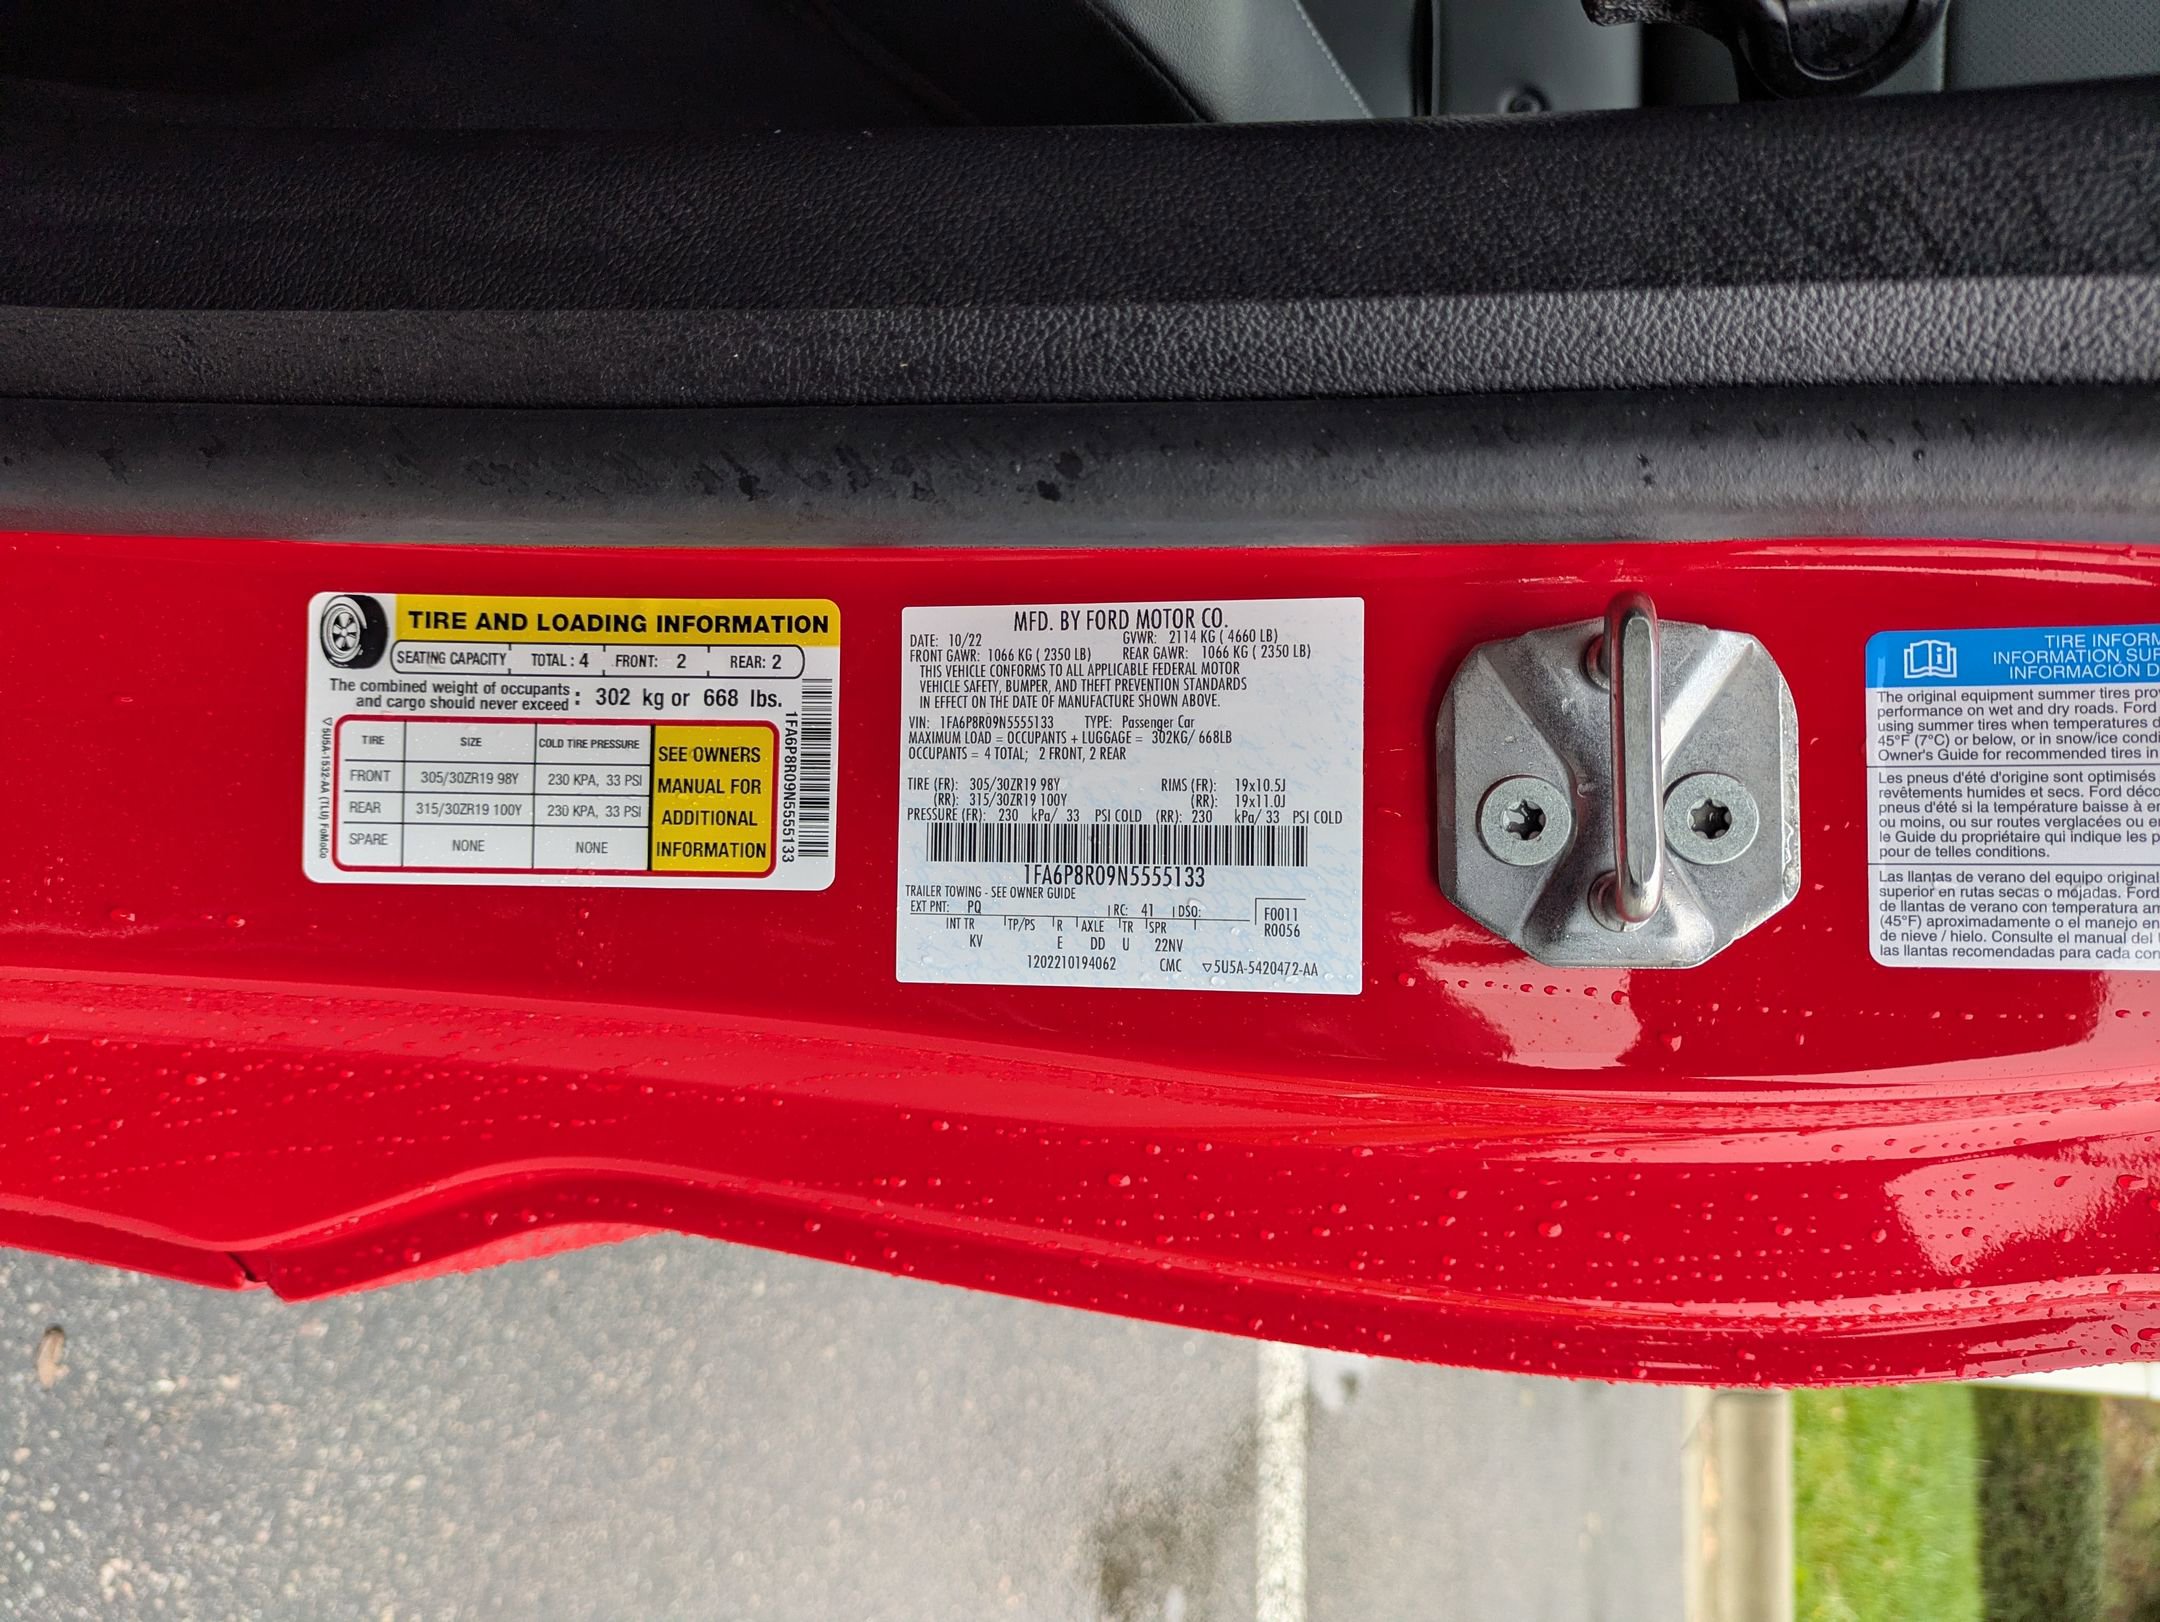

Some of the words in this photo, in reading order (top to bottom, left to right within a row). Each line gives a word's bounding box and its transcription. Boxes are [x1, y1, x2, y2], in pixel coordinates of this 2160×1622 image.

[407, 610, 466, 630] TIRE
[474, 612, 528, 631] AND
[536, 613, 646, 633] LOADING
[656, 614, 828, 633] INFORMATION
[1013, 610, 1053, 631] MFD.
[1060, 609, 1080, 631] BY
[1086, 609, 1129, 630] FORD
[1135, 607, 1195, 629] MOTOR
[1201, 607, 1228, 628] CO.
[910, 633, 938, 647] DATE:
[949, 632, 981, 648] 10/22
[1122, 630, 1157, 644] GVWR:
[1169, 629, 1196, 644] 2114
[1200, 629, 1215, 643] KG
[1227, 628, 1256, 643] 4660
[1260, 628, 1278, 644] LB)
[2044, 634, 2086, 648] TIRE
[396, 650, 445, 664] SEATING
[449, 651, 506, 666] CAPACITY
[578, 652, 589, 668] 4
[615, 654, 657, 667] FRONT:
[676, 653, 686, 668] 2
[730, 655, 765, 668] REAR:
[771, 654, 781, 669] 2
[1993, 648, 2119, 665] INFORMATION
[919, 664, 942, 678] THIS
[945, 664, 986, 677] VEHICLE
[989, 663, 1046, 677] CONFORMS
[1048, 663, 1062, 677] TO
[1065, 663, 1084, 676] ALL
[1087, 662, 1148, 676] APPLICABLE
[1152, 661, 1197, 675] FEDERAL
[1200, 661, 1240, 675] MOTOR
[2009, 660, 2140, 679] INFORMACIÓN
[329, 677, 355, 691] The
[359, 679, 427, 693] combined
[431, 680, 478, 697] weight
[482, 681, 496, 694] of
[500, 682, 570, 698] occupants
[919, 679, 960, 693] VEHICLE
[963, 679, 1001, 695] SAFETY,
[1005, 678, 1051, 695] BUMPER,
[1054, 678, 1077, 692] AND
[1080, 678, 1111, 692] THEFT
[1114, 677, 1179, 691] PREVENTION
[1183, 676, 1247, 691] STANDARDS
[355, 694, 382, 707] and
[385, 697, 425, 711] cargo
[429, 695, 475, 709] should
[479, 699, 518, 710] never
[521, 697, 569, 711] exceed
[595, 687, 630, 705] 302
[642, 688, 664, 710] kg
[671, 692, 690, 706] or
[703, 688, 738, 707] 668
[750, 688, 782, 707] lbs.
[1877, 705, 1963, 720] performance
[1966, 706, 1984, 716] on
[1988, 703, 2013, 716] wet
[2017, 702, 2043, 715] and
[2047, 702, 2069, 717] dry
[2074, 701, 2118, 714] roads.
[2123, 700, 2156, 713] Ford
[908, 715, 929, 729] VIN:
[940, 715, 1053, 729] 1FA6P8R09N5555133
[1084, 715, 1112, 728] TYPE:
[1122, 715, 1173, 732] Passenger
[1177, 714, 1195, 728] Car
[361, 735, 384, 745] TIRE
[459, 736, 482, 747] SIZE
[538, 737, 564, 748] COLD
[566, 738, 588, 748] TIRE
[590, 739, 640, 749] PRESSURE
[658, 745, 688, 762] SEE
[692, 746, 761, 763] OWNERS
[1878, 748, 1933, 761] Owner's
[1937, 748, 1978, 760] Guide
[1982, 747, 2001, 760] for
[2005, 746, 2106, 760] recommended
[2110, 746, 2141, 759] tires
[2146, 745, 2158, 758] in
[349, 768, 391, 782] FRONT
[420, 770, 494, 786] 305/30ZR19
[496, 772, 519, 784] 98Y
[547, 772, 570, 785] 230
[573, 773, 599, 787] KPA,
[605, 773, 620, 786] 33
[624, 773, 642, 786] PSI
[1878, 771, 1903, 784] Les
[1906, 773, 1949, 786] pneus
[1952, 770, 1986, 783] d'été
[1990, 770, 2049, 786] d'origine
[2053, 770, 2083, 783] sont
[2087, 769, 2156, 785] optimisés
[657, 777, 725, 794] MANUAL
[730, 778, 761, 794] FOR
[781, 711, 798, 863] 1FA6P8R09N5555133
[907, 777, 929, 790] TIRE
[934, 777, 958, 792] (FR):
[969, 776, 1036, 792] 305/30ZR19
[1040, 777, 1060, 791] 98Y
[1161, 777, 1187, 791] RIMS
[1190, 777, 1216, 793] (FR):
[1235, 777, 1285, 792] 19x10.5J
[348, 800, 381, 813] REAR
[933, 792, 958, 807] (RR):
[969, 791, 1036, 808] 315/30ZR19
[1040, 792, 1067, 806] 100Y
[318, 796, 331, 820] (TLU)
[415, 802, 489, 817] 315/30ZR19
[493, 803, 522, 816] 100Y
[546, 804, 569, 816] 230
[572, 804, 598, 818] KPA,
[605, 805, 620, 817] 33
[623, 805, 641, 818] PSI
[661, 809, 758, 826] ADDITIONAL
[318, 823, 329, 859] FoMoCo
[348, 832, 388, 845] SPARE
[452, 839, 485, 852] NONE
[575, 841, 608, 854] NONE
[656, 841, 766, 858] INFORMATION
[1879, 847, 1910, 860] pour
[1913, 845, 1931, 857] de
[1935, 845, 1971, 857] telles
[1975, 845, 2050, 857] conditions.
[1024, 864, 1204, 887] 1FA6P8R09N5555133
[1879, 870, 1903, 882] Las
[1907, 870, 1952, 884] llantas
[1956, 870, 1973, 883] de
[1977, 873, 2025, 883] verano
[2029, 870, 2050, 883] del
[2055, 870, 2103, 886] equipo
[2107, 870, 2159, 887] original
[1113, 903, 1128, 916] RC:
[1140, 903, 1153, 917] 41
[1264, 906, 1297, 921] F0011
[1264, 922, 1300, 937] R0056
[1154, 937, 1183, 952] 22NV
[1027, 954, 1116, 970] 1202210194062
[1159, 957, 1181, 972] CMC
[1213, 959, 1318, 976] 5U5A-5420472-AA
